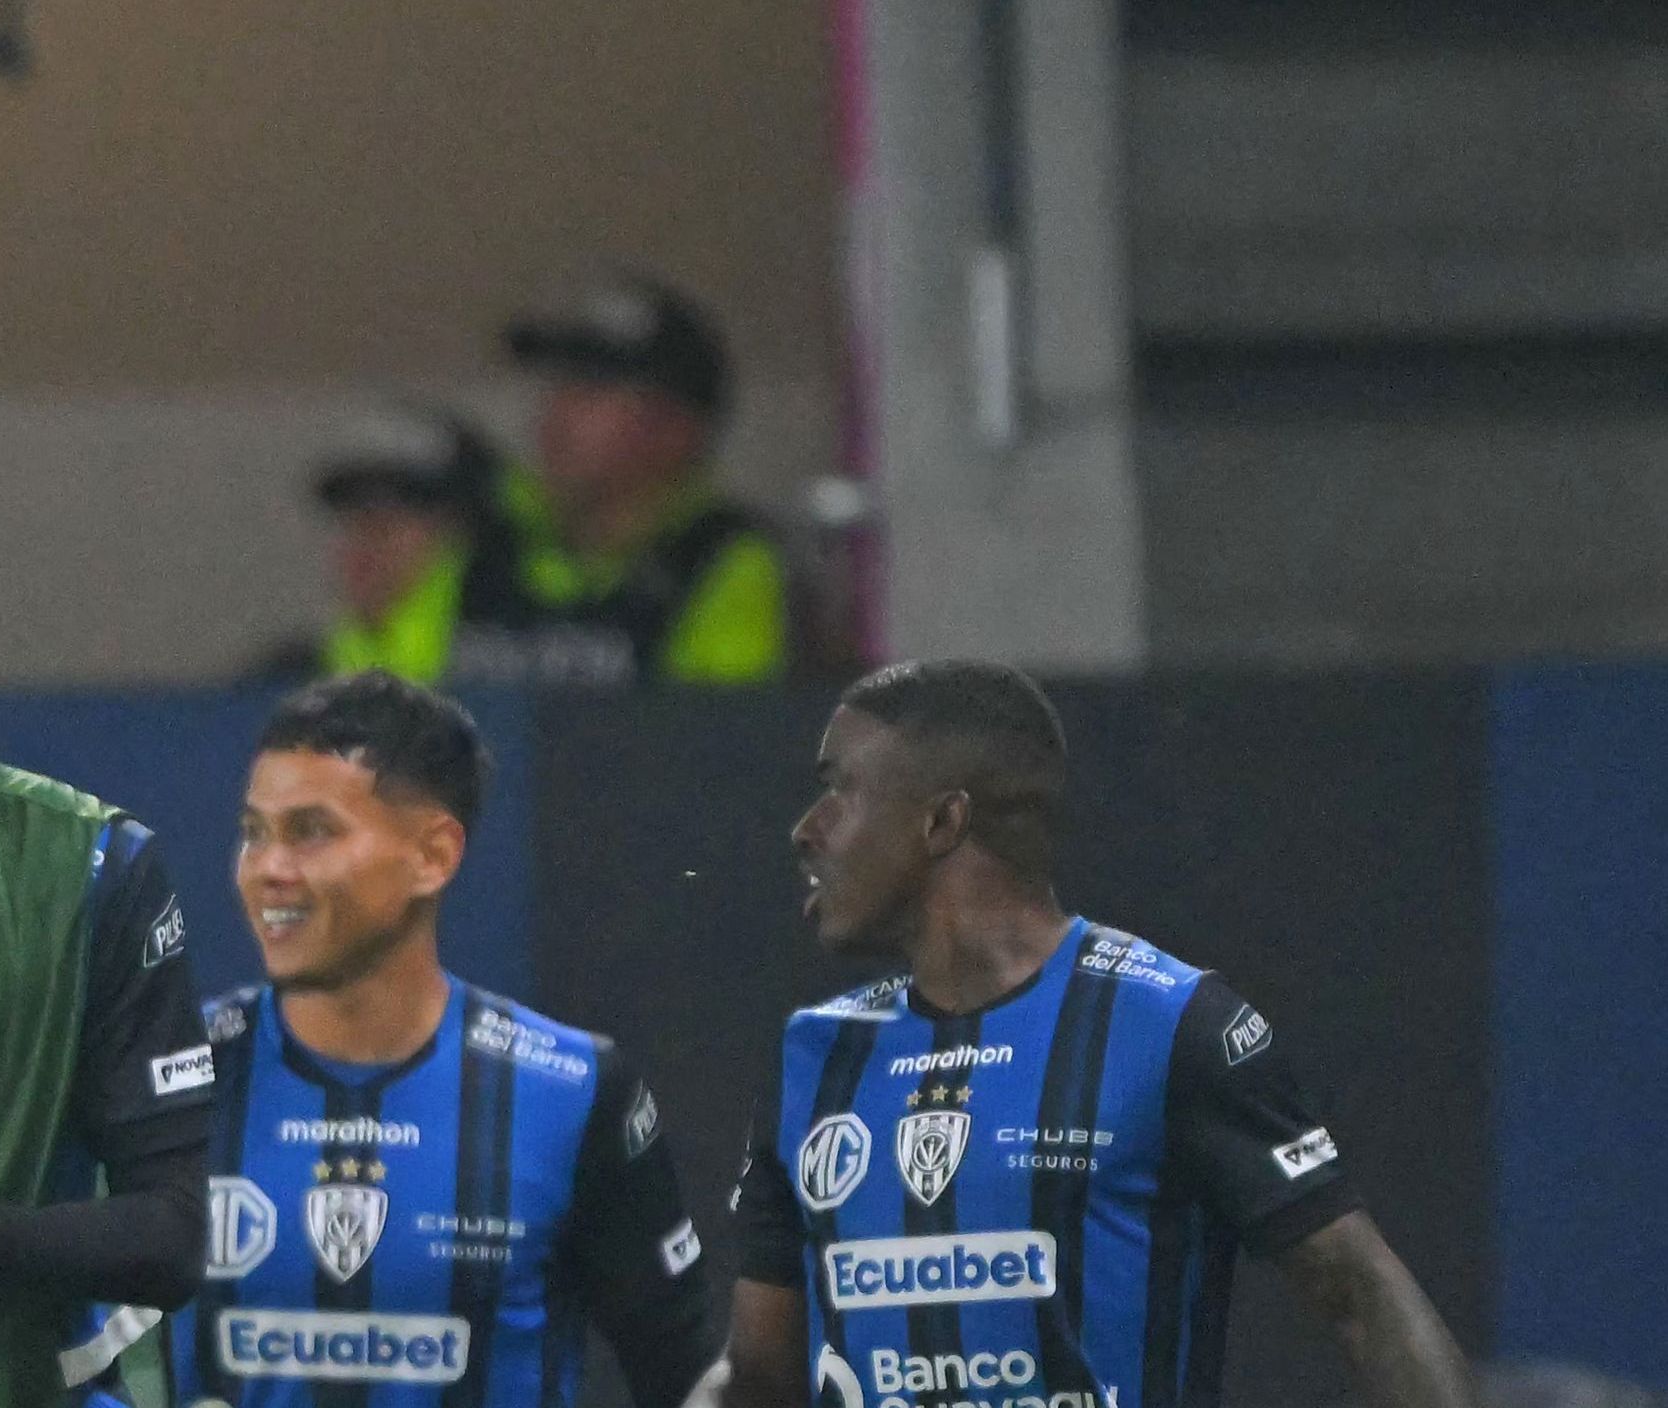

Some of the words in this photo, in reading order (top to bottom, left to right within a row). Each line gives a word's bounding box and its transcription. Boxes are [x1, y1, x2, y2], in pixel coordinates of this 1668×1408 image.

[1093, 940, 1157, 964] Banco
[1082, 953, 1116, 971] del
[1115, 959, 1177, 987] Barrio
[480, 1009, 557, 1049] Banco
[515, 1040, 589, 1076] Barrio
[890, 1043, 1013, 1077] marathon
[280, 1116, 421, 1148] marathon
[996, 1127, 1115, 1146] CHUBB
[803, 1118, 867, 1204] MG
[1007, 1154, 1099, 1172] SEGUROS
[417, 1211, 527, 1239] CHUBB
[832, 1243, 1047, 1298] Ecuabet
[229, 1318, 459, 1369] Ecuabet
[872, 1348, 1036, 1394] Banco
